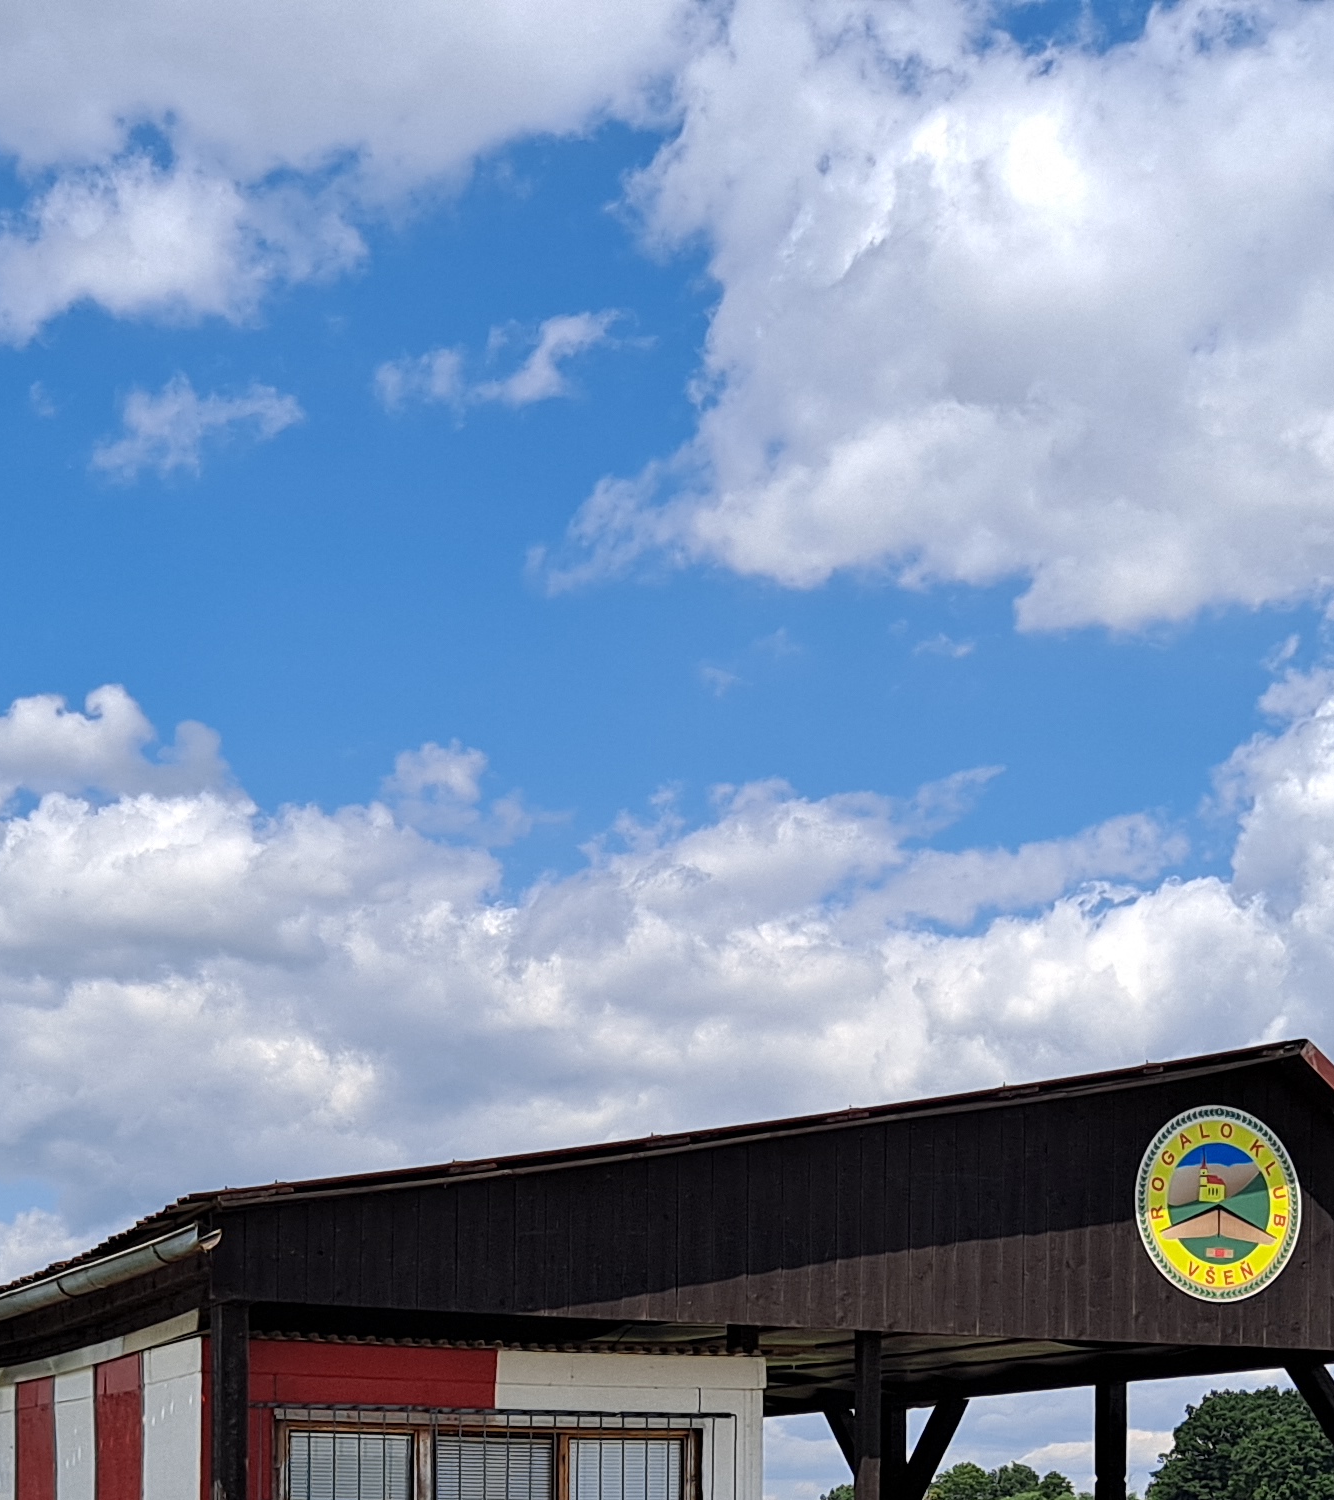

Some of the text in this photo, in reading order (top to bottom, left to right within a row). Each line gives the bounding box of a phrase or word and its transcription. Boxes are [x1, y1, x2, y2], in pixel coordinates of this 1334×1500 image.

[1150, 1122, 1287, 1228] ROGALO KLUB
[1187, 1260, 1254, 1286] VŠEŇ
